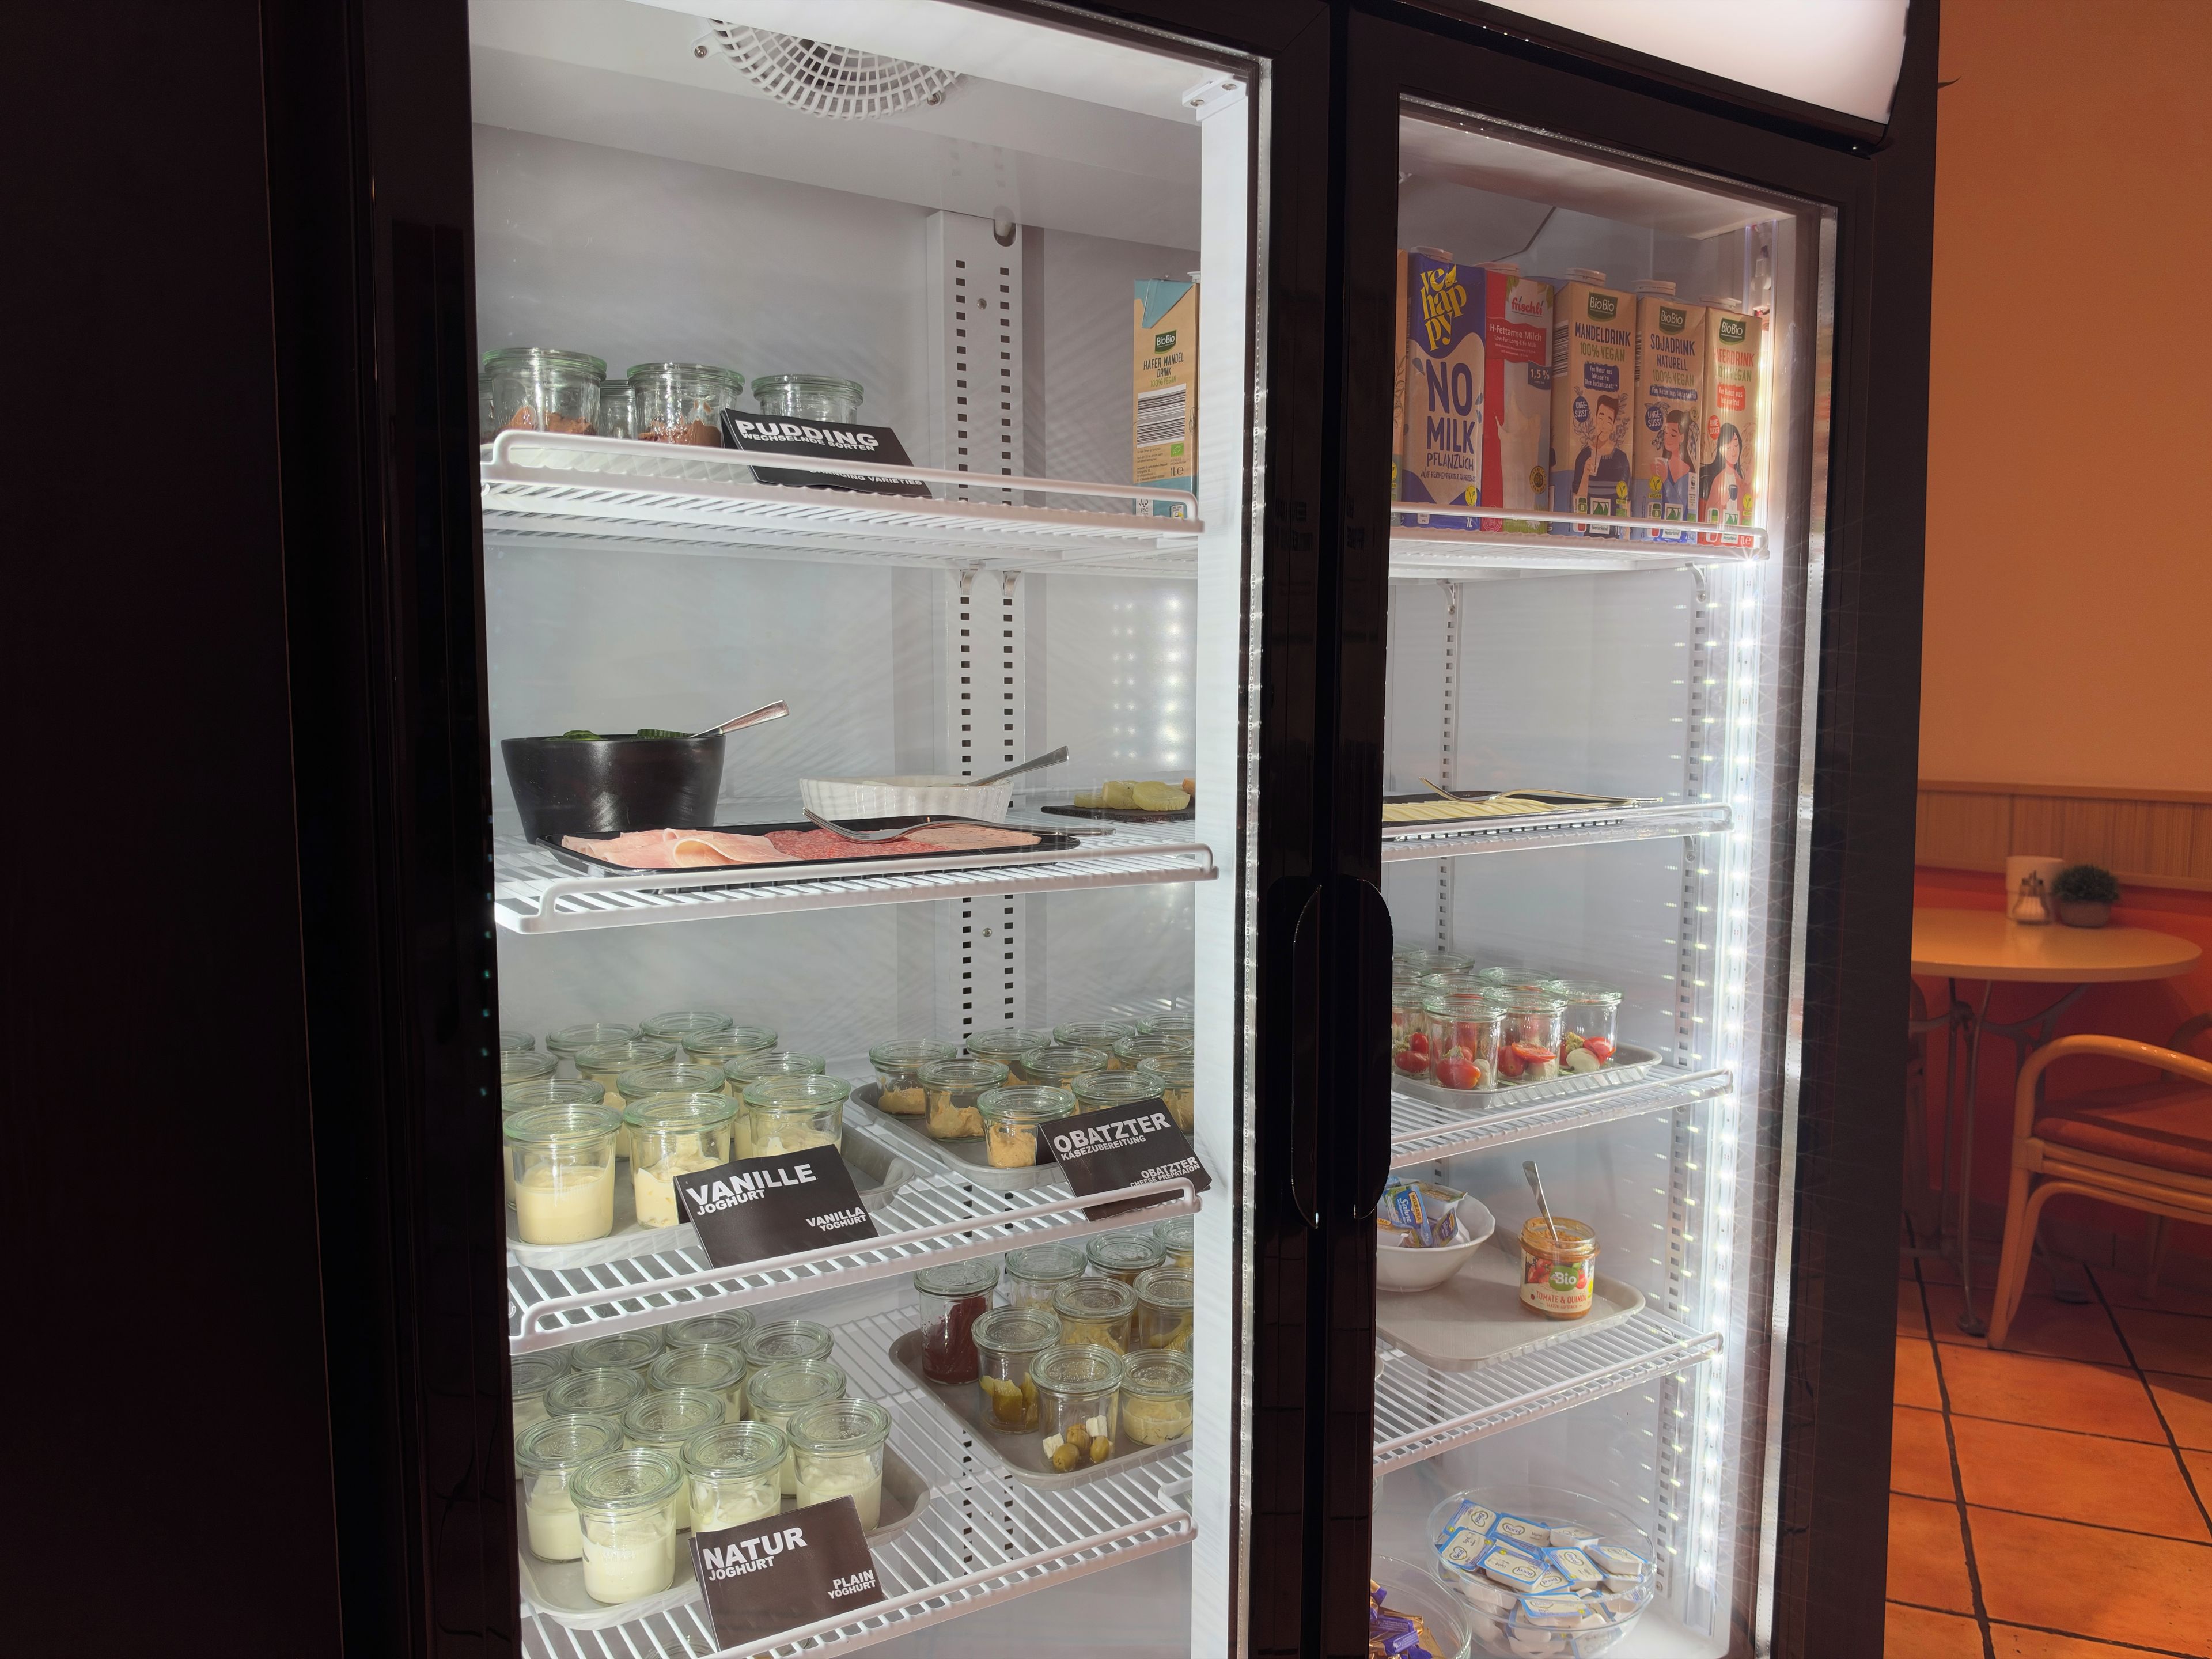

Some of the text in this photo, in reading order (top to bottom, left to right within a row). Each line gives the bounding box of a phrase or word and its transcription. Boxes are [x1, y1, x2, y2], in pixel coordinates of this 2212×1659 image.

[1590, 296, 1615, 312] BioBio
[1661, 310, 1683, 325] BioBio
[1490, 324, 1542, 342] H-Fettarme Milch
[1575, 321, 1631, 347] MANDELDRINK
[1722, 321, 1743, 336] BioBio
[1157, 335, 1175, 346] BioBio
[1650, 334, 1695, 357] SOJADRINK
[1143, 352, 1184, 370] HAFER MANDEL
[1580, 342, 1625, 362] 100% VEGAN
[1657, 354, 1688, 371] NATURELL
[1157, 367, 1171, 378] DRINK
[1164, 376, 1176, 385] VEGAN
[1530, 368, 1541, 379] 1,5
[1653, 369, 1694, 387] 100% VEGAN
[1426, 359, 1473, 416] NO
[735, 419, 880, 447] PUDDING
[741, 433, 876, 452] WECHSELNDE SORTEN
[1426, 415, 1475, 454] MILK
[868, 476, 922, 486] VARIETIES
[1054, 1112, 1171, 1153] OBATZTER
[1061, 1135, 1146, 1161] KÄSEZUBEREITUNG
[1130, 1164, 1200, 1188] CHEESE PREPATAION
[1141, 1156, 1198, 1179] OBATZTER
[686, 1164, 817, 1205] VANILLE
[697, 1189, 766, 1215] JOGHURT
[806, 1207, 865, 1227] VANILLA
[819, 1214, 867, 1232] YOGHURT
[1536, 1290, 1558, 1303] TOMATE
[1567, 1294, 1586, 1304] QUINOA
[703, 1527, 808, 1570] NATUR
[709, 1556, 775, 1581] JOGHURT
[828, 1579, 876, 1599] YOGHURT
[833, 1570, 874, 1589] PLAIN
